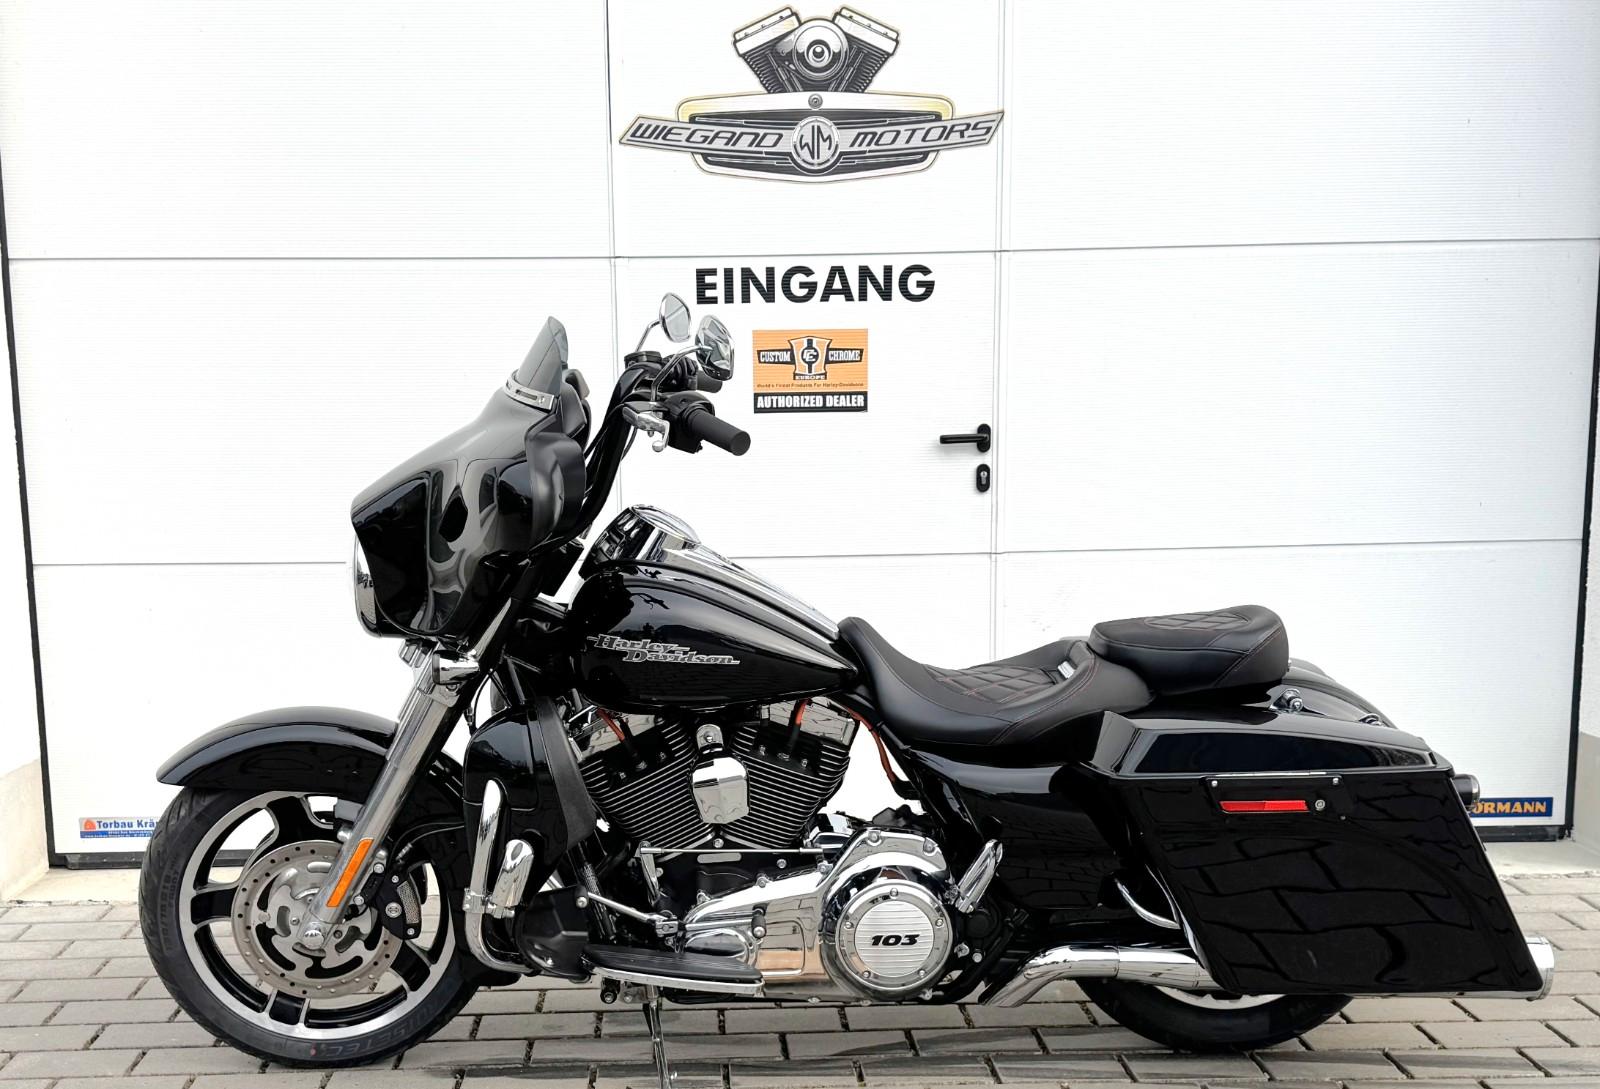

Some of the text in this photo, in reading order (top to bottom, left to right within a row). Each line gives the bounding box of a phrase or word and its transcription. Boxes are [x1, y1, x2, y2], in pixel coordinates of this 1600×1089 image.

[630, 123, 783, 148] WIEGAND
[850, 120, 997, 147] MOTORS
[696, 264, 936, 305] EINGANG
[760, 351, 791, 362] CUSTOM
[828, 350, 860, 362] CHROME
[757, 395, 864, 408] AUTHORIZED DEALER
[622, 649, 740, 665] Davidson
[96, 819, 158, 829] Torbau Krä
[871, 934, 920, 947] 103
